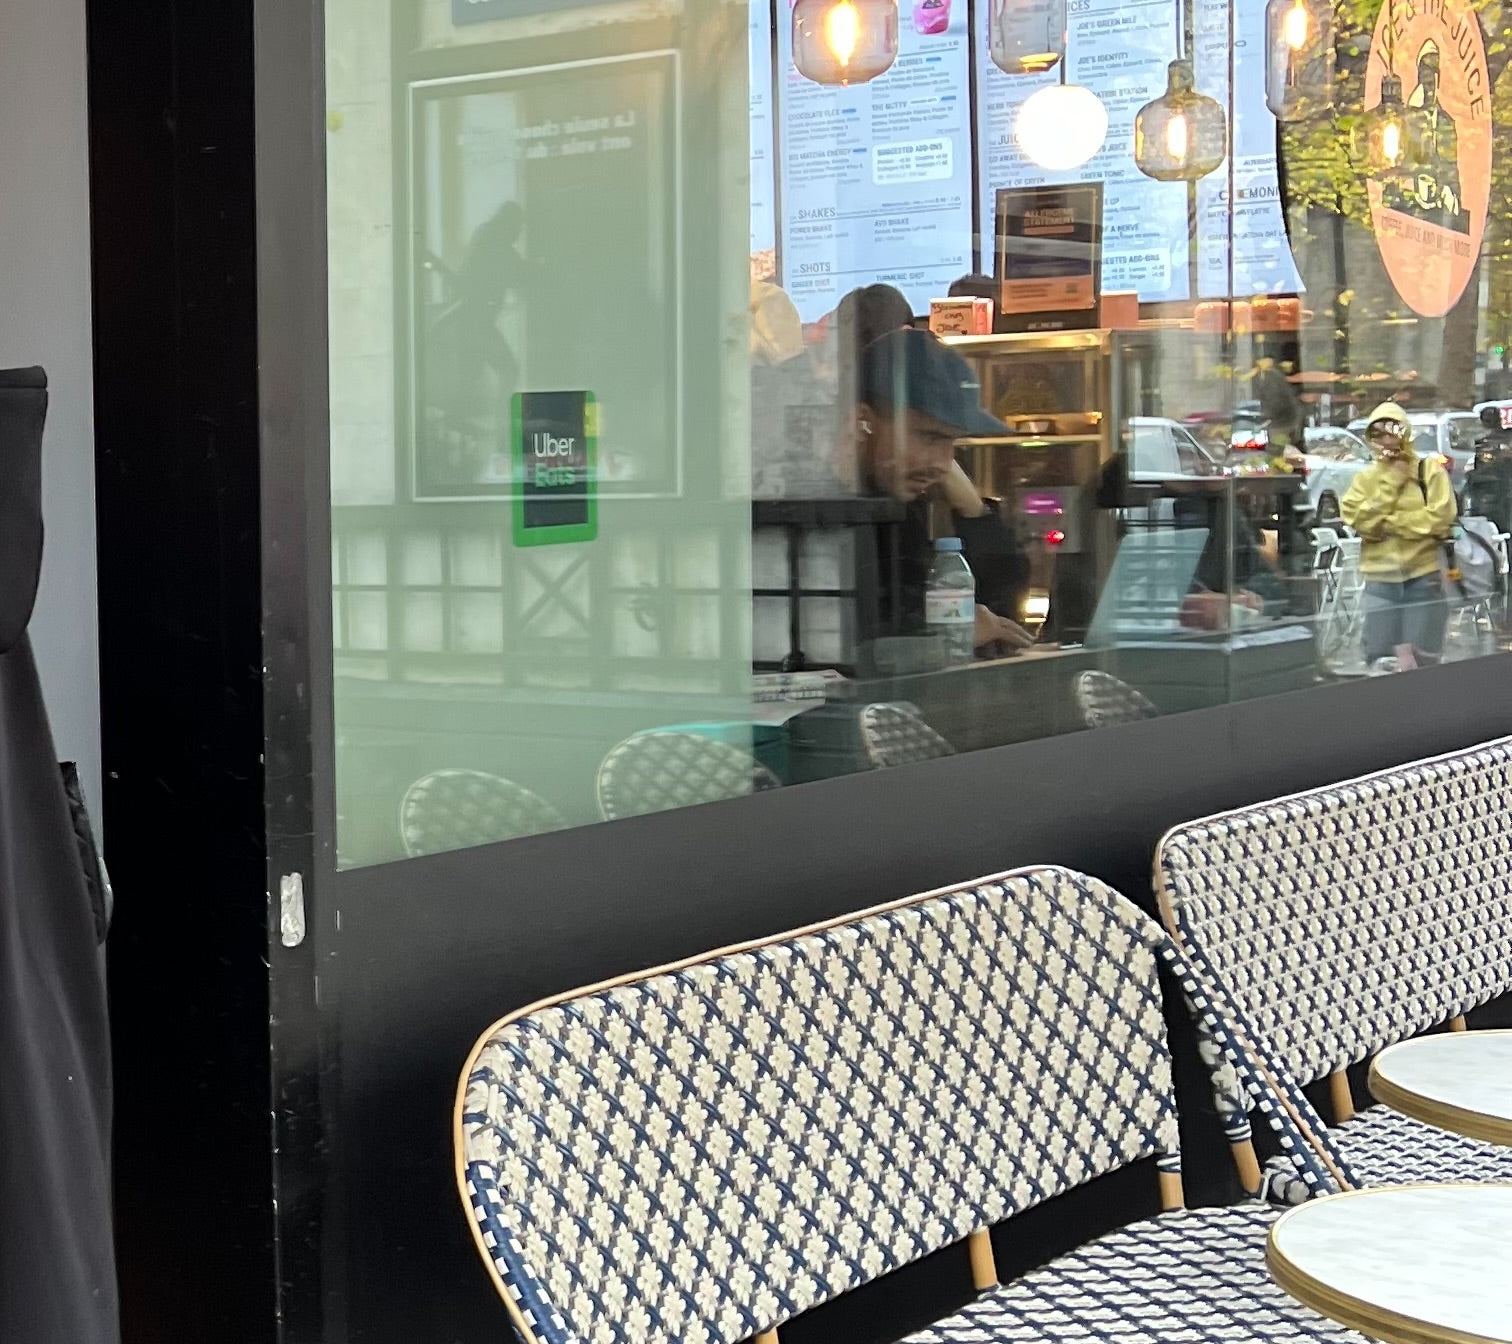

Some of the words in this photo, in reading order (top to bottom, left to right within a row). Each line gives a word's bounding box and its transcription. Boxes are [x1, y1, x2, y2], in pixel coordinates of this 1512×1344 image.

[1450, 15, 1485, 121] JUICE
[798, 207, 837, 221] SHAKES
[799, 262, 831, 273] SHOTS
[533, 432, 575, 458] Uber
[534, 463, 576, 488] Eats
